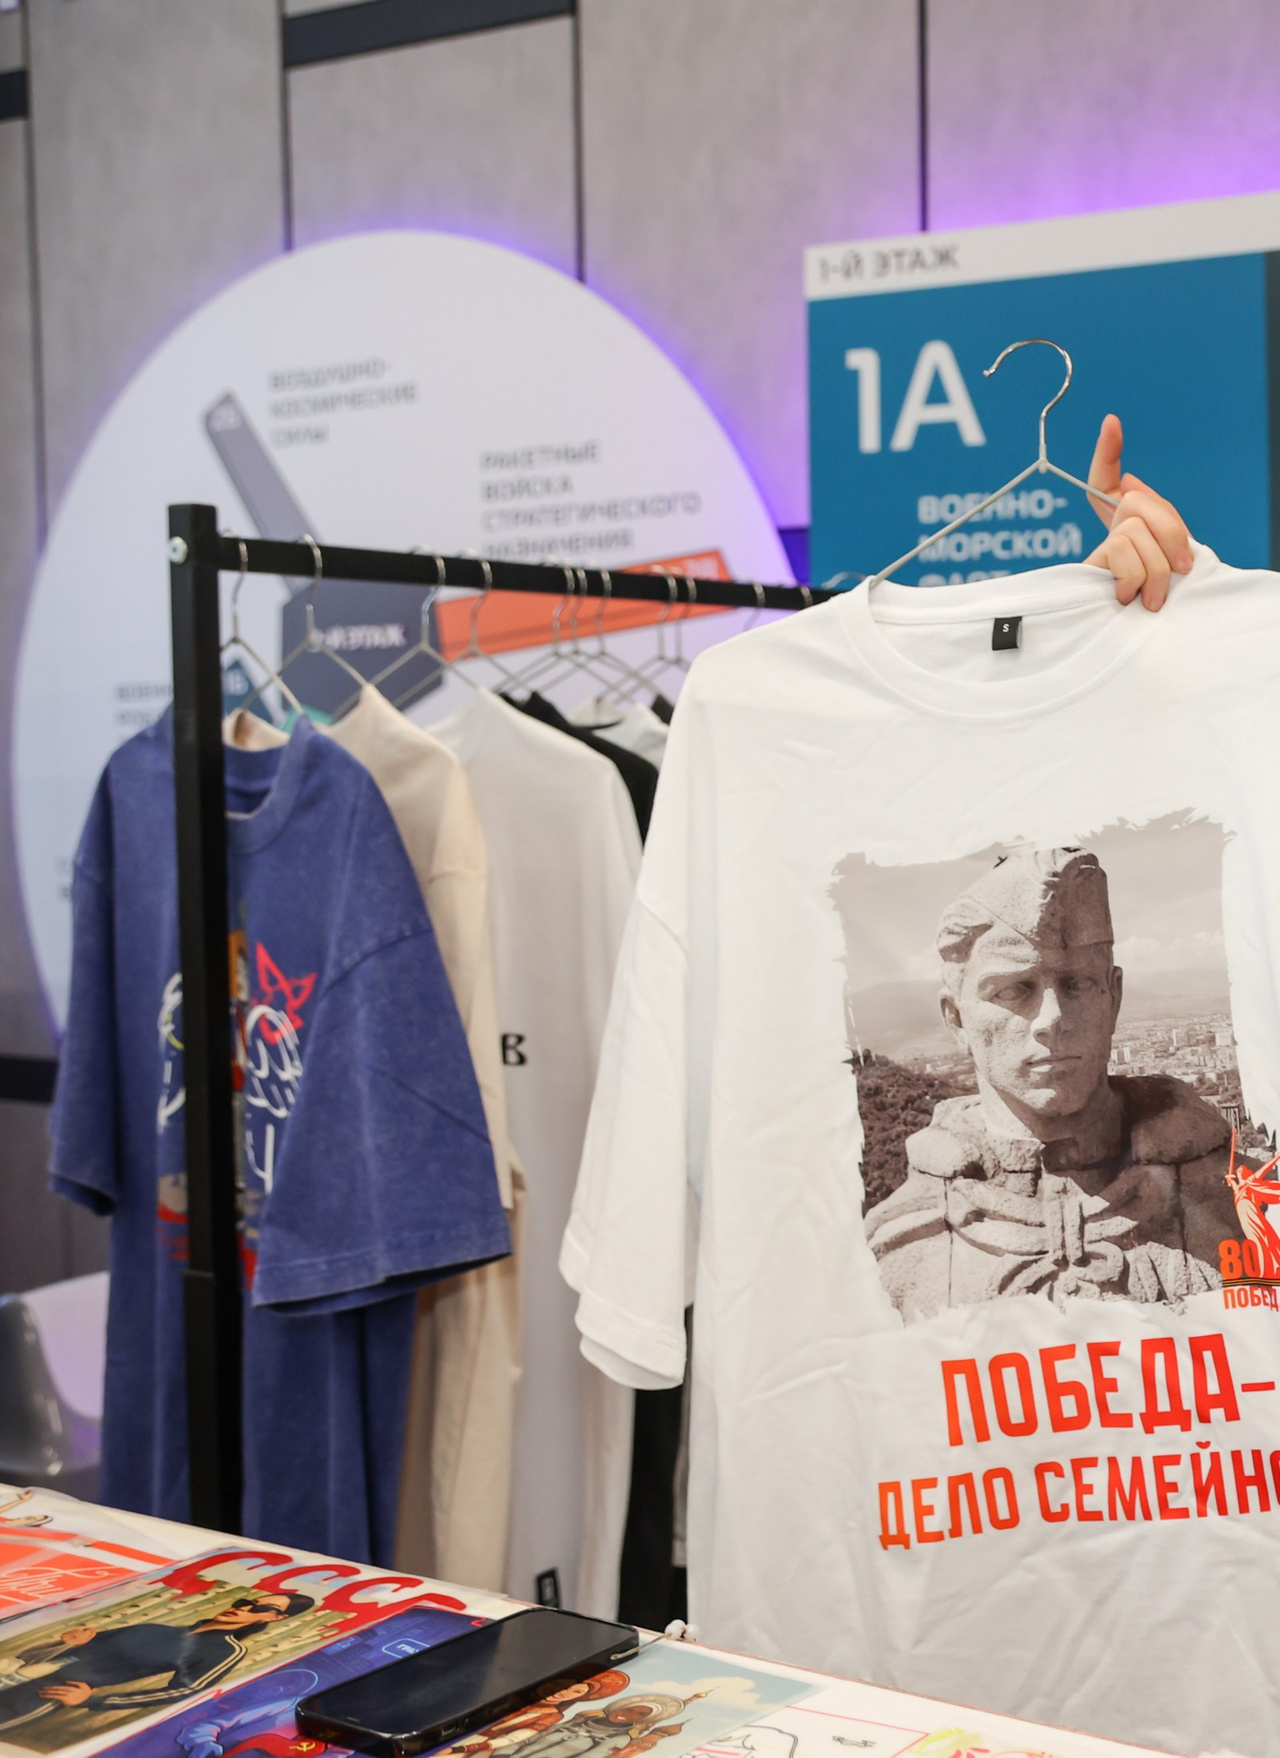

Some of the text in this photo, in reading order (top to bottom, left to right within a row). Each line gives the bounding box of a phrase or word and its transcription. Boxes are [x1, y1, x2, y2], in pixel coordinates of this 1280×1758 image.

[873, 242, 961, 280] ЭТАЖ
[844, 339, 987, 454] 1А
[481, 440, 602, 470] РАКЕТНЫЕ
[482, 473, 575, 502] ВОЙСКА
[482, 492, 703, 532] СТРАТЕГИЧЕСКОГО
[917, 522, 1083, 562] МОРСКОЙ
[1217, 1238, 1262, 1280] 80
[877, 1466, 1021, 1551] ДЕЛО
